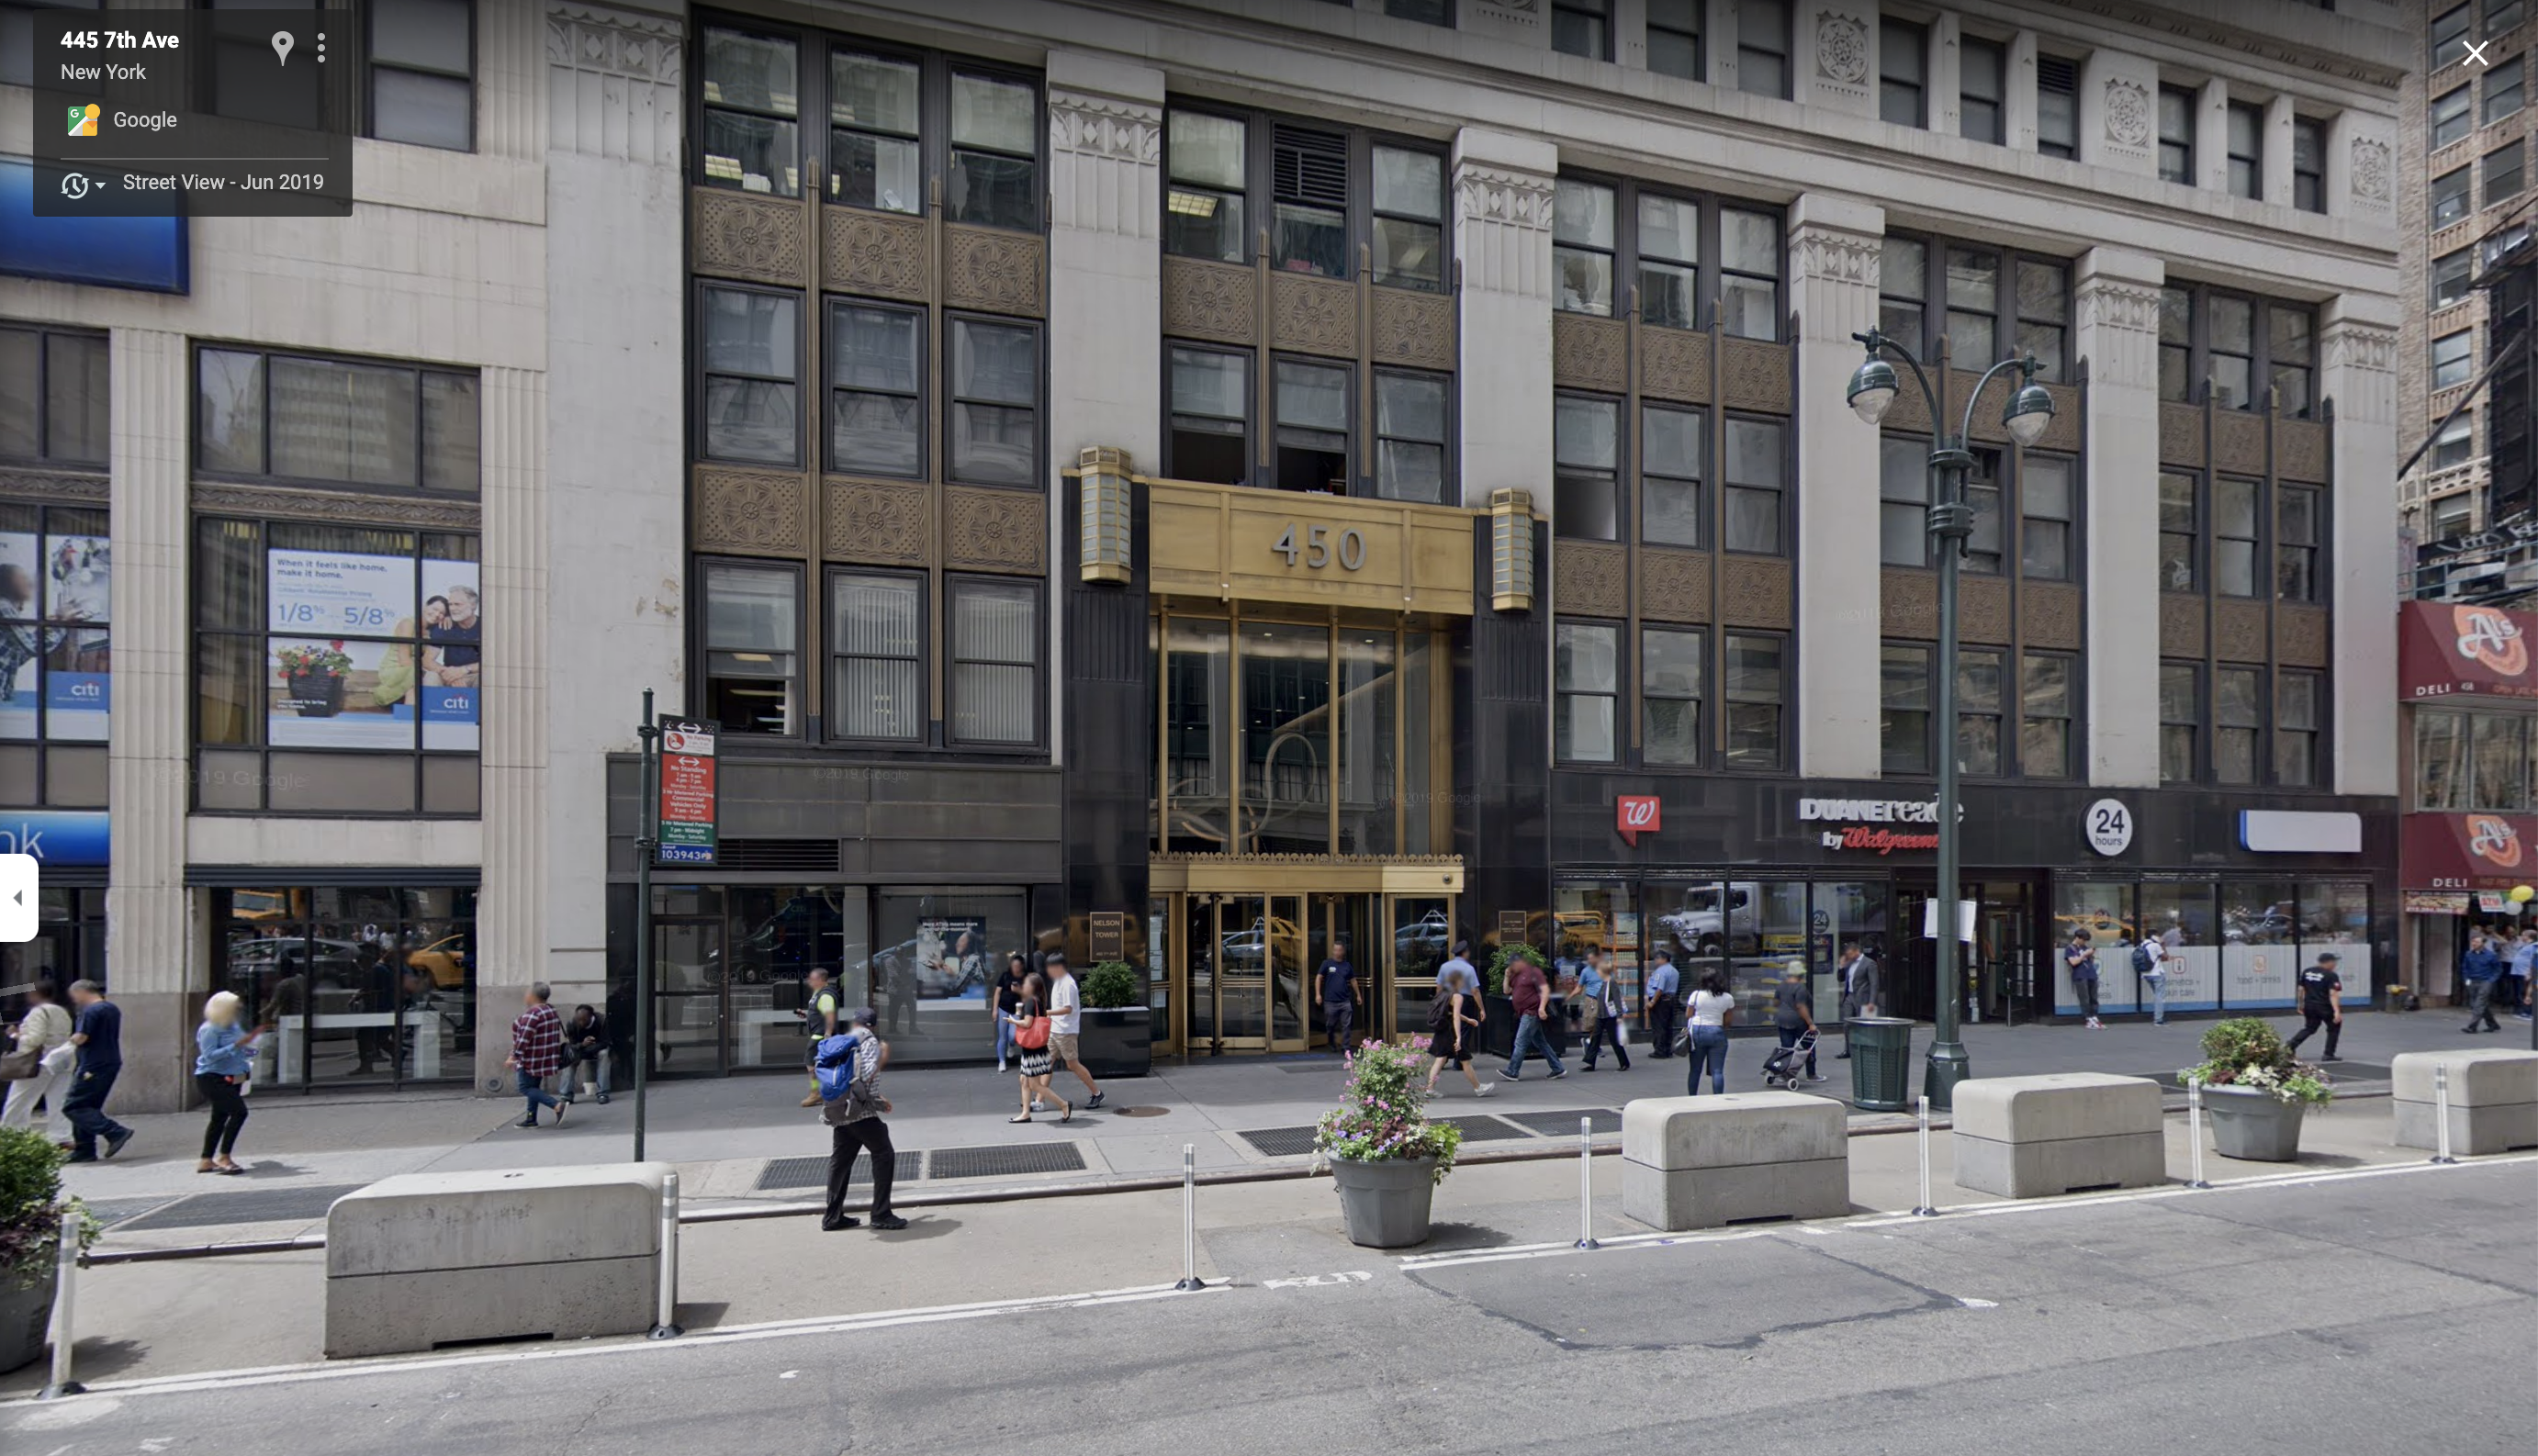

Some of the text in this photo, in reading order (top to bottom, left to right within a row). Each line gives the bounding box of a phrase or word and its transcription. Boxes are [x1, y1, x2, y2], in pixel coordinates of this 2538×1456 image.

[1271, 522, 1367, 571] 450
[277, 558, 303, 566] When
[317, 560, 338, 569] feels
[341, 562, 357, 570] like
[277, 568, 302, 577] make
[305, 569, 312, 577] it
[71, 682, 100, 696] citi
[2416, 683, 2451, 697] DELI
[444, 696, 469, 709] citi
[681, 766, 707, 775] Standing
[2095, 808, 2125, 834] 24
[1823, 831, 1844, 850] by
[2094, 834, 2123, 846] hours
[662, 849, 702, 860] 103943
[2433, 878, 2468, 888] DELI
[1814, 913, 1828, 924] 24
